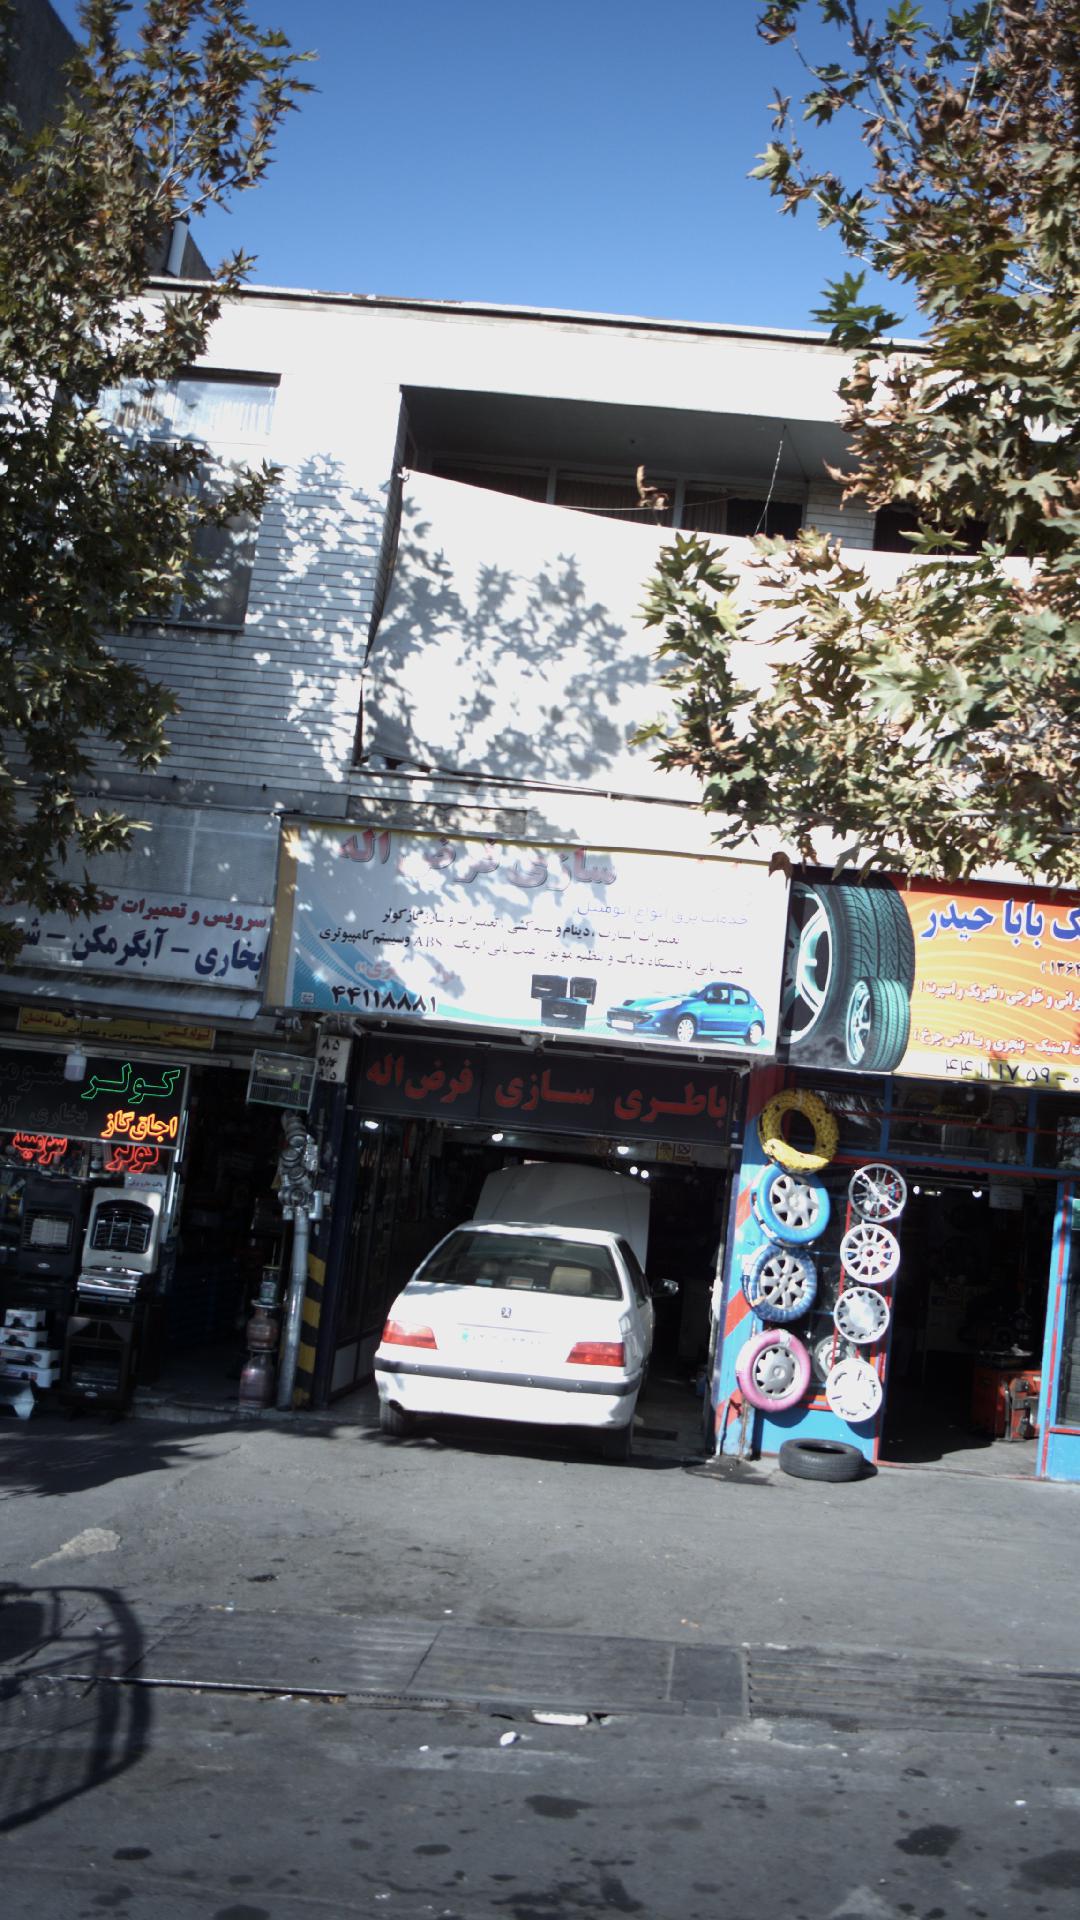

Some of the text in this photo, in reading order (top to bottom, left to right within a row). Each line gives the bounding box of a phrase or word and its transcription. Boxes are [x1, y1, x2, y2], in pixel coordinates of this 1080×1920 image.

[121, 898, 187, 920] تعمیرات
[189, 909, 201, 925] و
[203, 911, 267, 931] سرویس
[382, 907, 407, 924] کولر
[920, 902, 994, 940] حیدر
[1003, 900, 1044, 947] بابا
[72, 924, 170, 967] آبگرمکن
[319, 927, 374, 945] کامپیوتری
[195, 939, 265, 977] بخاری
[331, 985, 436, 1013] ۴۴۱۱۸۸۸۱
[1045, 995, 1054, 1008] و
[81, 1062, 181, 1104] کولر
[366, 1053, 404, 1087] اله
[404, 1057, 474, 1103] فرض
[495, 1069, 595, 1111] سازی
[613, 1081, 728, 1129] باطری
[101, 1109, 135, 1139] گاز
[130, 1114, 178, 1143] اجاق
